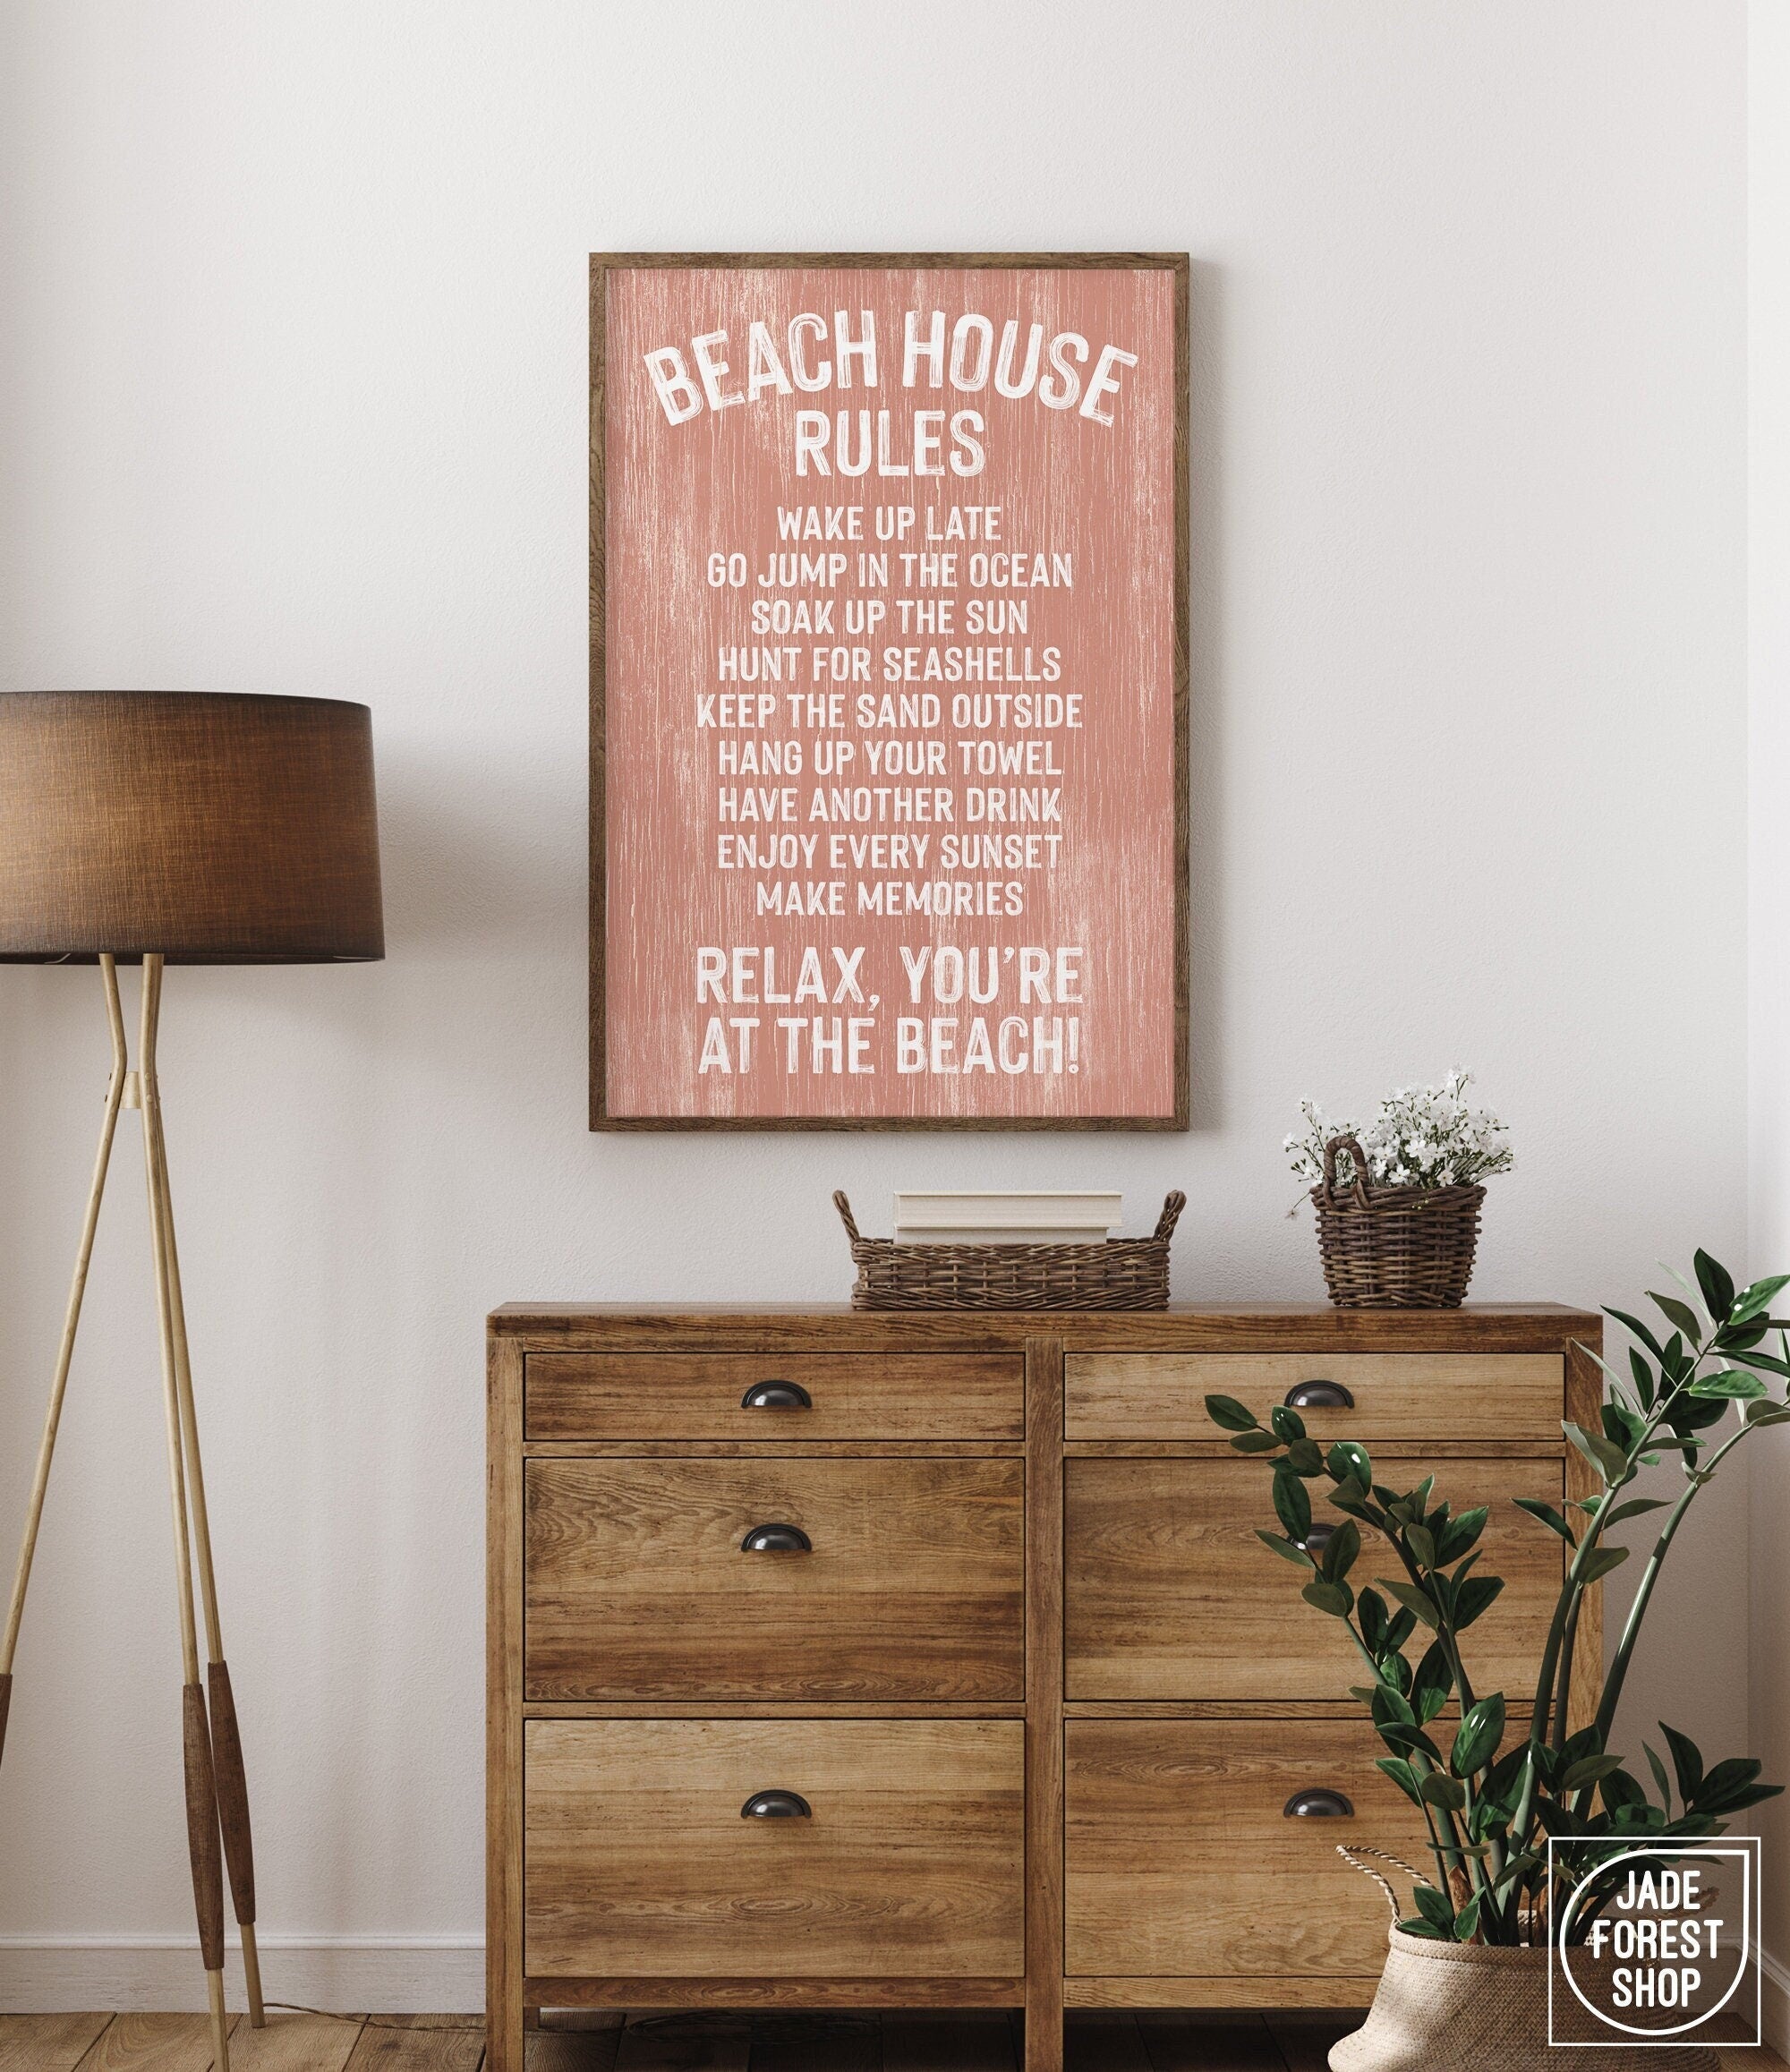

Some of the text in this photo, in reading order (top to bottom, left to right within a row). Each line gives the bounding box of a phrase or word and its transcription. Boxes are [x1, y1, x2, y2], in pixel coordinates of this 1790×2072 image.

[644, 310, 1138, 428] BEACH HOUSE
[796, 409, 986, 477] RULES
[777, 506, 1002, 541] WAKE UP LATE
[707, 553, 1073, 588] GO JUMP IN THE OCEAN
[751, 600, 1028, 635] SOAK UP THE SUN
[718, 647, 1061, 682] HUNT FOR SEASHELLS
[696, 694, 1083, 729] KEEP THE SAND OUTSIDE
[719, 740, 1062, 775] HANG UP YOUR TOWEL
[719, 787, 1062, 822] HAVE ANOTHER DRINK
[718, 834, 1063, 869] ENJOY EVERY SUNSET
[756, 882, 1024, 916] MAKE MEMORIES
[696, 946, 1084, 1012] RELAX, YOU’RE
[698, 1017, 1079, 1075] AT THE BEACH!
